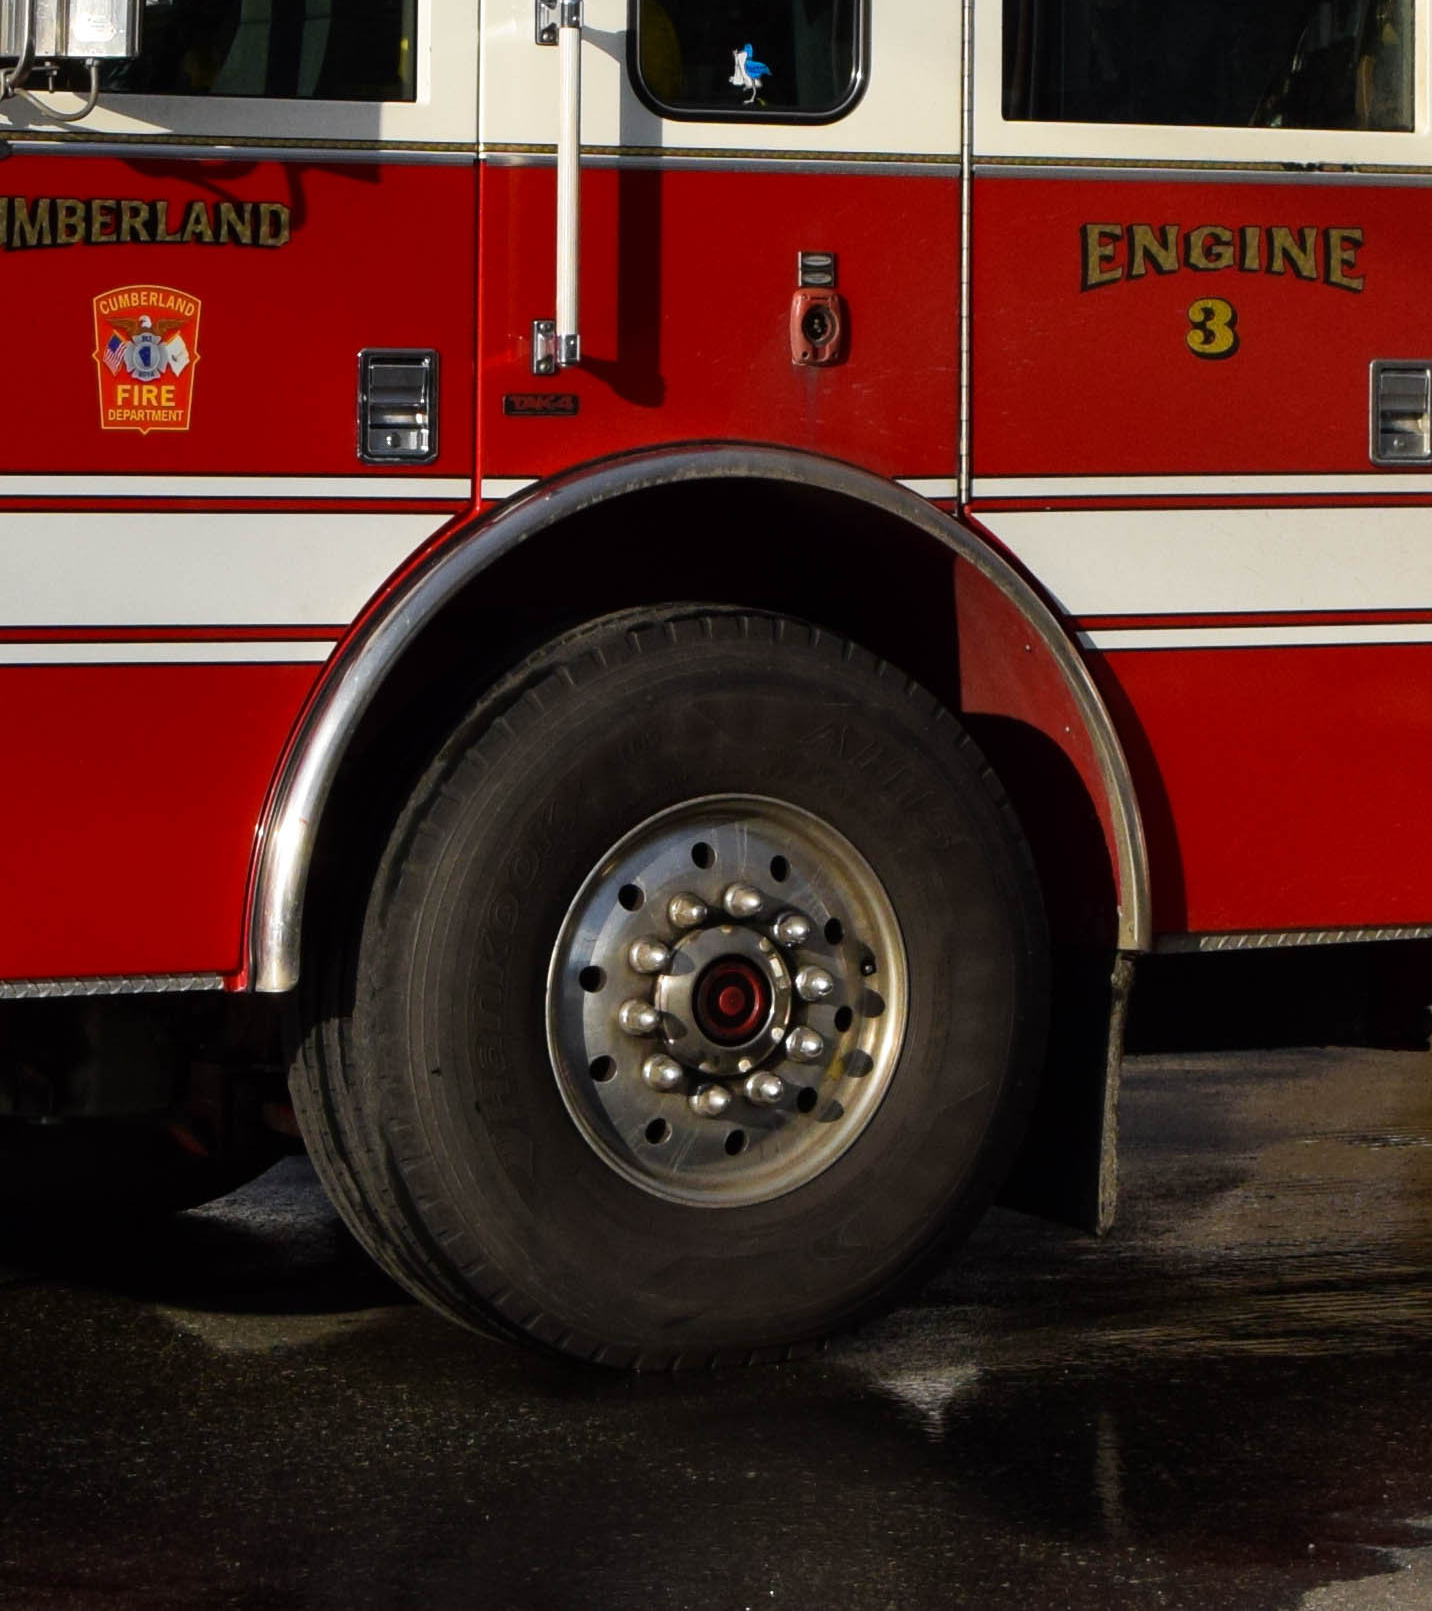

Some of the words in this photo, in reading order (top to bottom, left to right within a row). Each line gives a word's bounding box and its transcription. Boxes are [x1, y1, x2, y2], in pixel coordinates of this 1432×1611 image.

[1080, 223, 1365, 292] ENGINE
[99, 291, 195, 316] CUMBERLAND
[1185, 297, 1240, 360] 3
[117, 384, 176, 407] FIRE
[108, 409, 184, 422] DEPARTMENT
